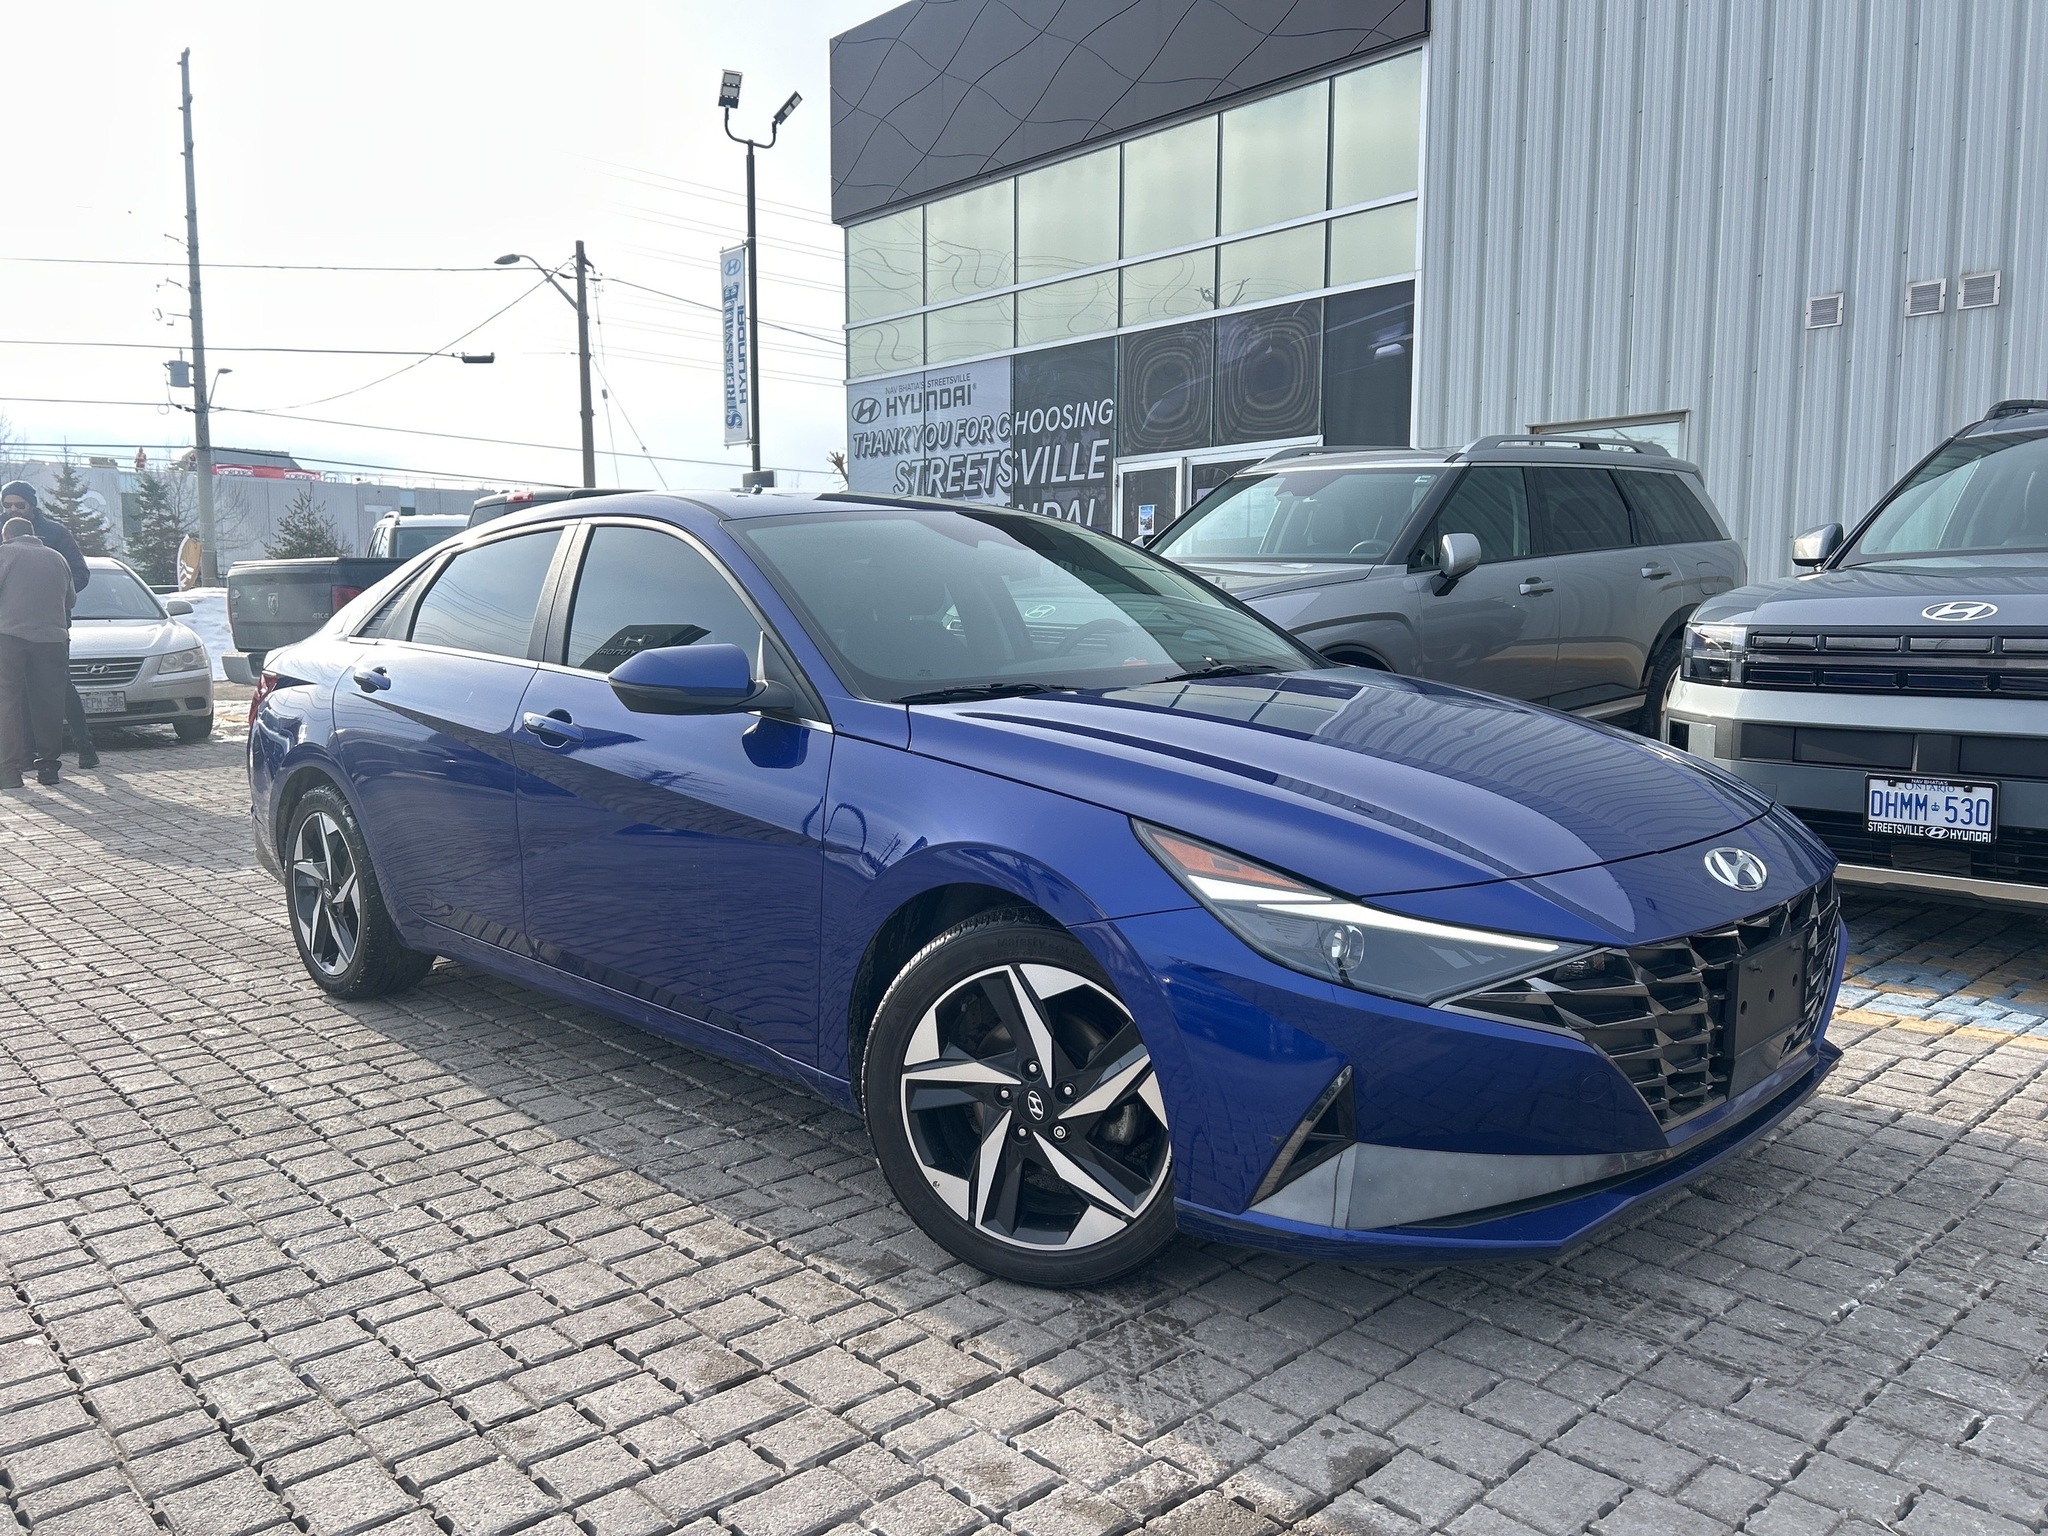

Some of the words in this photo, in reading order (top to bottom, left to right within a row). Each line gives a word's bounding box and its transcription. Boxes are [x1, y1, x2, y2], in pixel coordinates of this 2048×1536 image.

[723, 282, 742, 429] STREETSVILLE
[737, 306, 746, 404] HYUNDAI
[885, 385, 897, 394] NAV
[899, 381, 925, 392] BHATIA'S
[927, 373, 971, 388] STREETSVILLE
[853, 427, 912, 457] THANK
[912, 420, 951, 451] YOU
[954, 414, 994, 446] FOR
[996, 398, 1114, 440] CHOOSING
[893, 439, 1110, 496] STREETSVILLE
[1871, 790, 1928, 821] DHMM
[1944, 796, 1989, 826] 530
[1904, 783, 1955, 793] ONTARIO
[1868, 821, 1924, 836] STREETSVILLE
[1950, 829, 1991, 843] HYUNDAI
